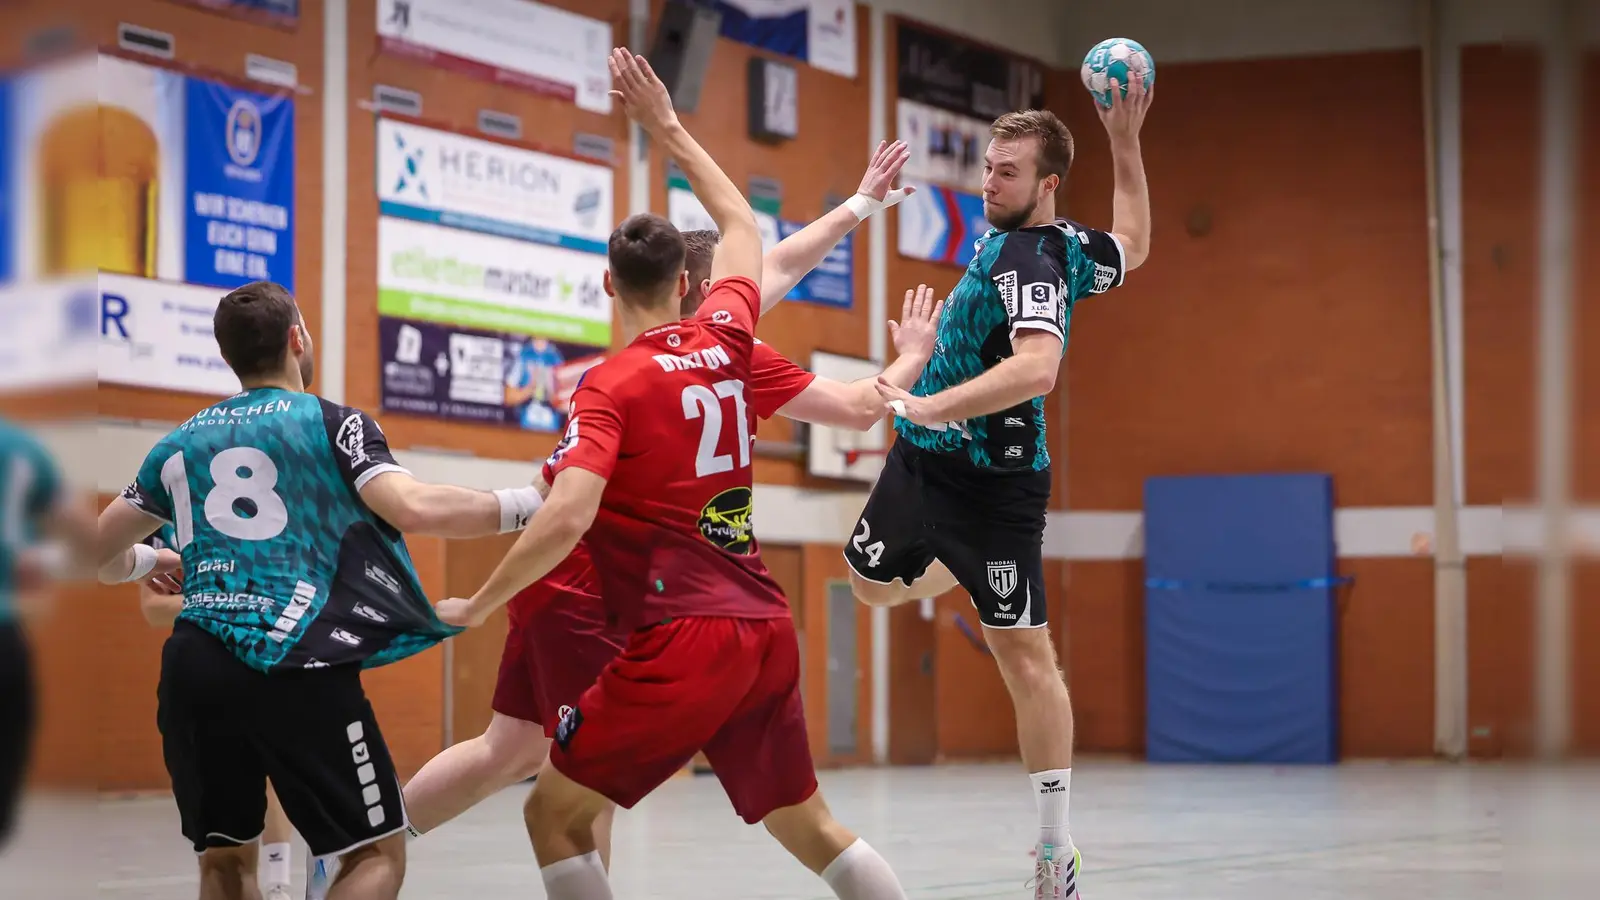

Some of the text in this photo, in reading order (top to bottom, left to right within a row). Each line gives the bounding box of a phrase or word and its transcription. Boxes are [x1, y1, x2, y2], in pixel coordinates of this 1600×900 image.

[439, 147, 560, 194] HERION
[181, 418, 252, 432] HANDBALL
[681, 379, 751, 478] 27
[160, 446, 288, 550] 18
[853, 518, 886, 568] 24
[197, 559, 235, 573] Gräsl
[992, 570, 1013, 593] HT
[994, 611, 1017, 620] erima
[1040, 786, 1066, 794] erima
